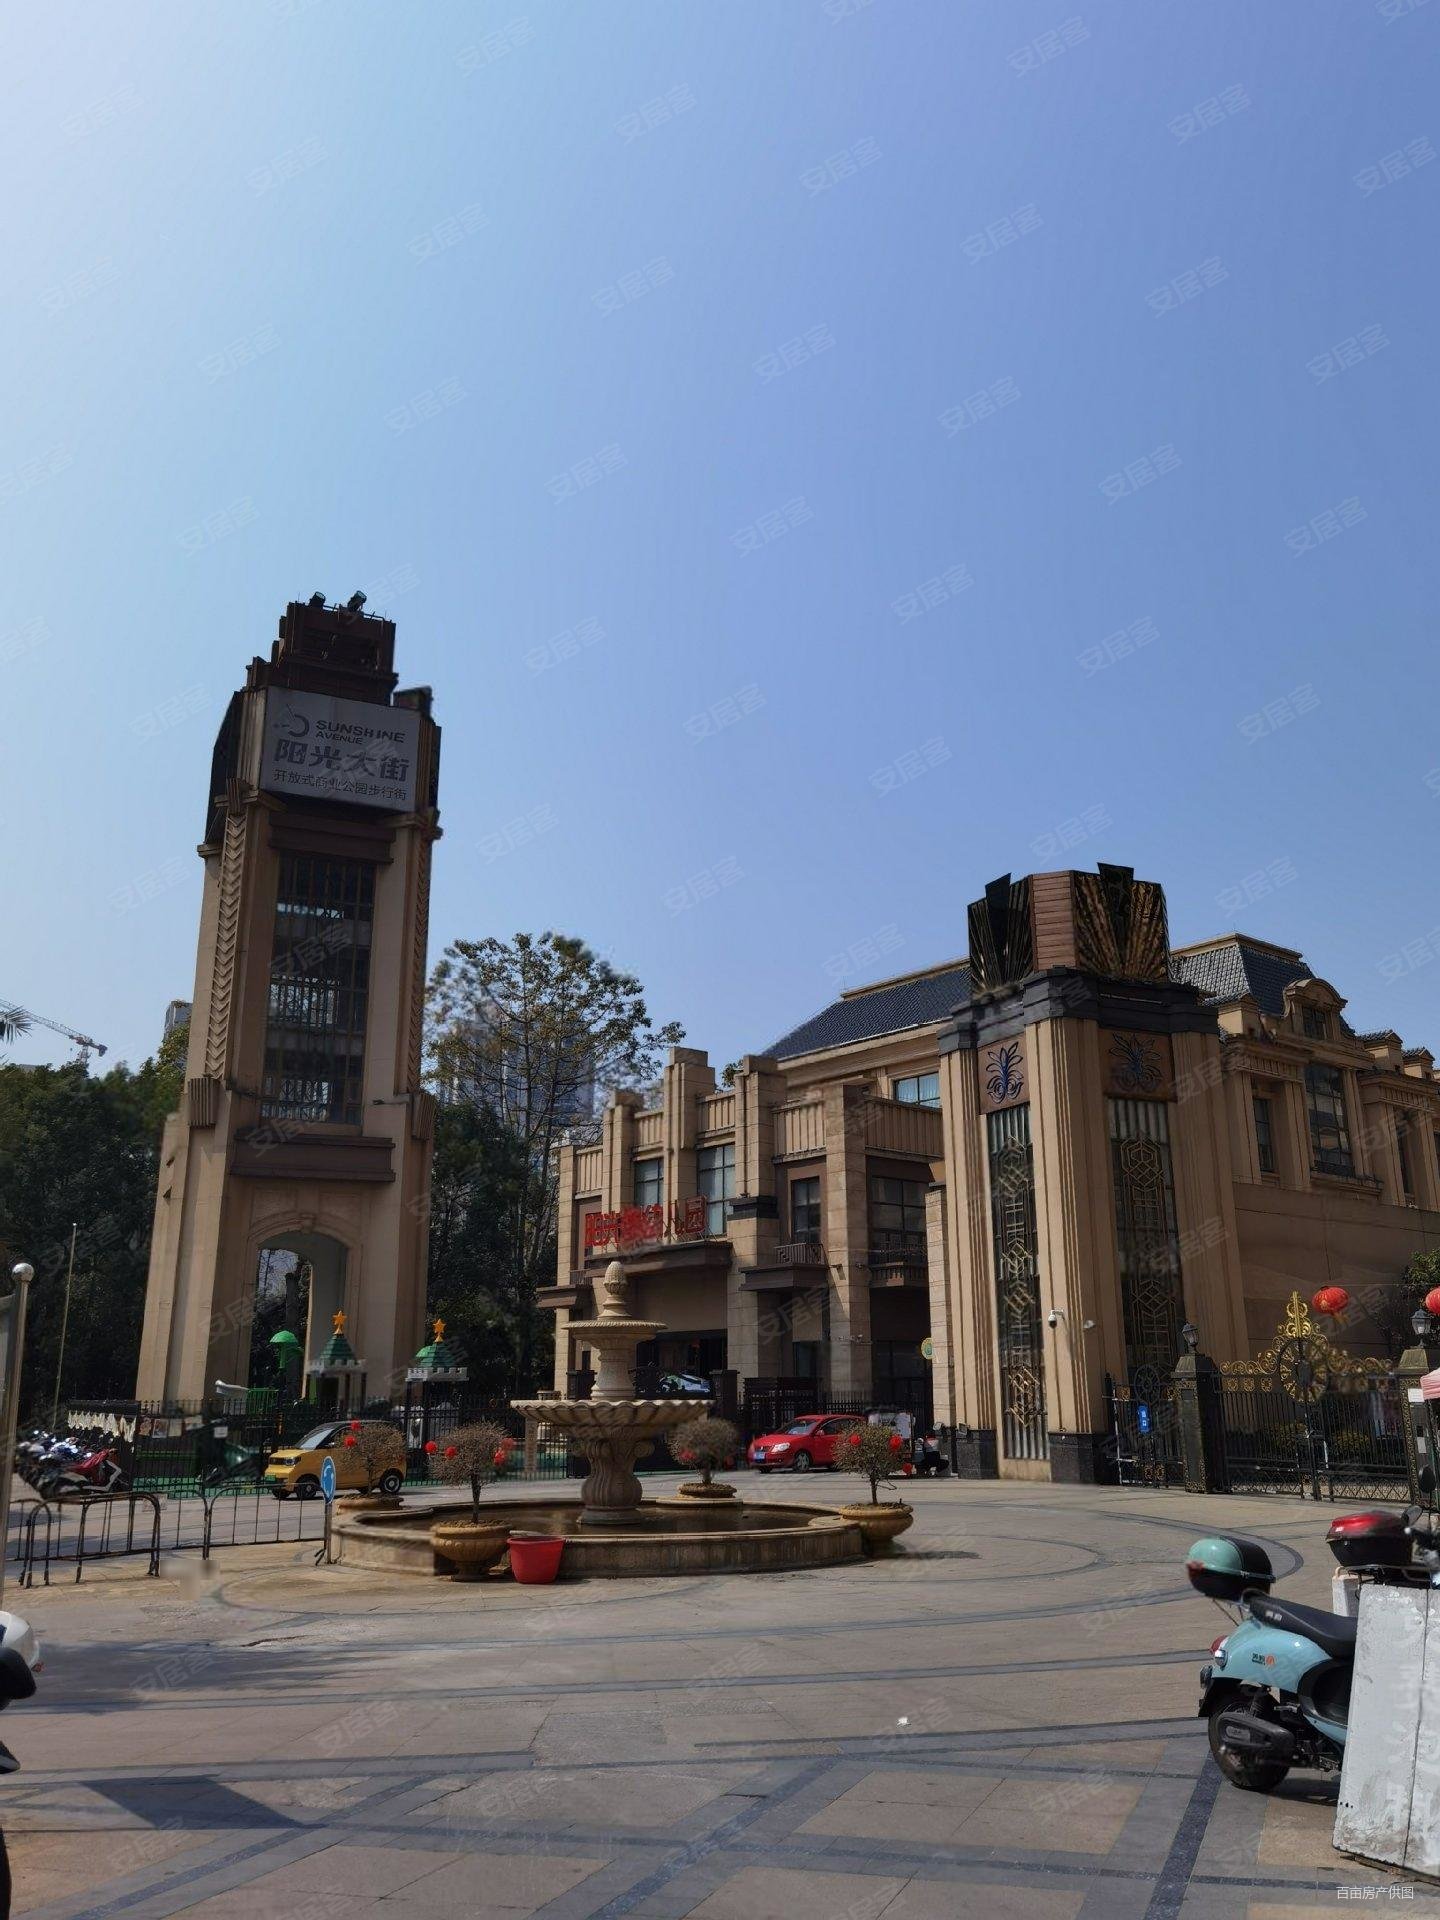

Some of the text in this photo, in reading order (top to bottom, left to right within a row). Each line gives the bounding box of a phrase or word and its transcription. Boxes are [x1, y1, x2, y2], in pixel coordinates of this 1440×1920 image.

[315, 719, 406, 743] SUNSHINE
[315, 731, 363, 745] AVENUE
[273, 739, 410, 782] 阳光大街
